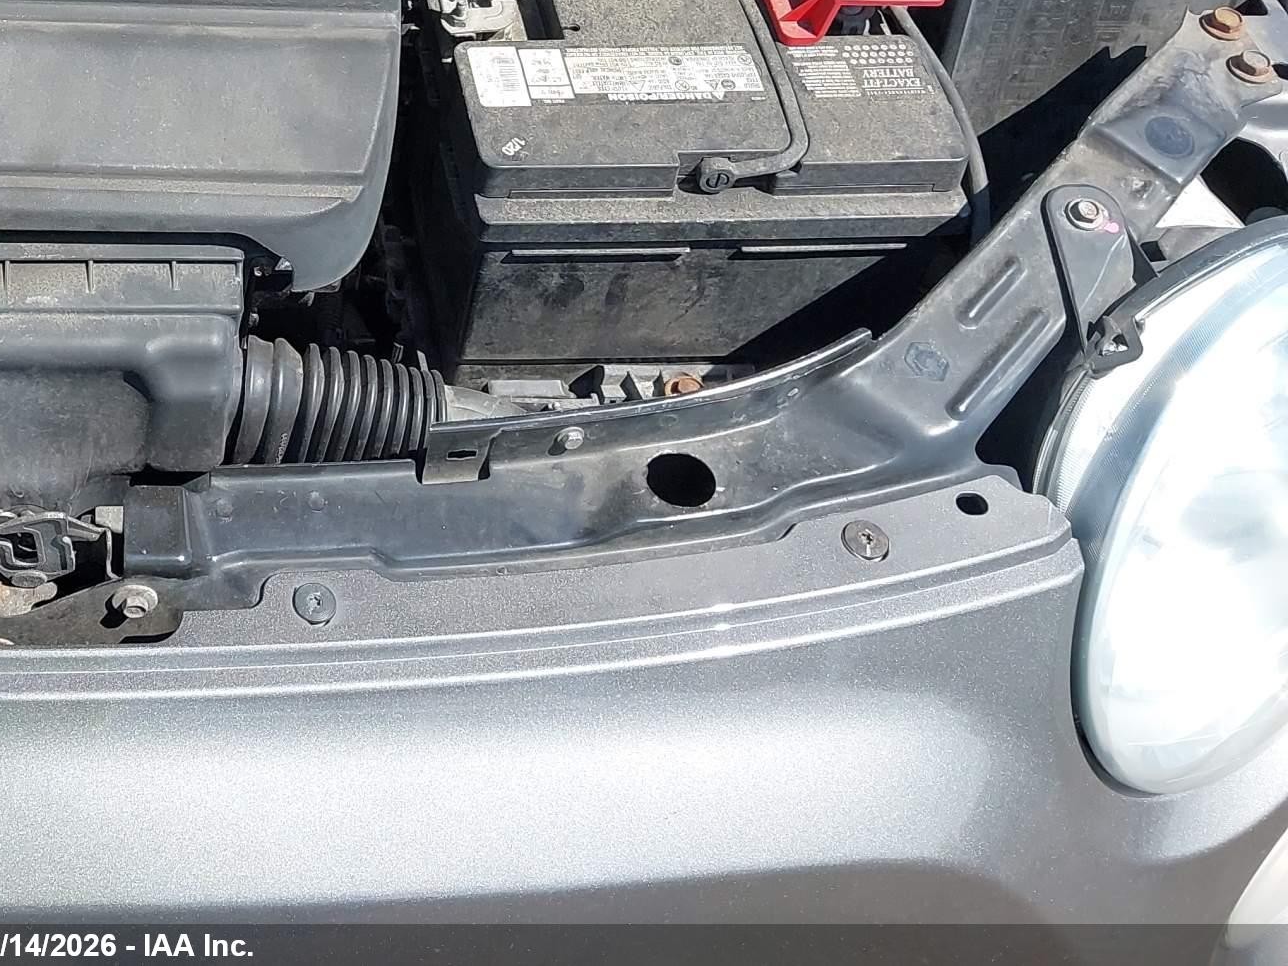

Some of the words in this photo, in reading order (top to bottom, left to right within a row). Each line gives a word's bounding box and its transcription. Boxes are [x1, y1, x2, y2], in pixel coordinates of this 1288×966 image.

[863, 68, 914, 78] BATTERY
[862, 78, 921, 88] EXACT-FIT
[607, 92, 712, 101] DANGER/POISON
[502, 137, 526, 156] 1/20
